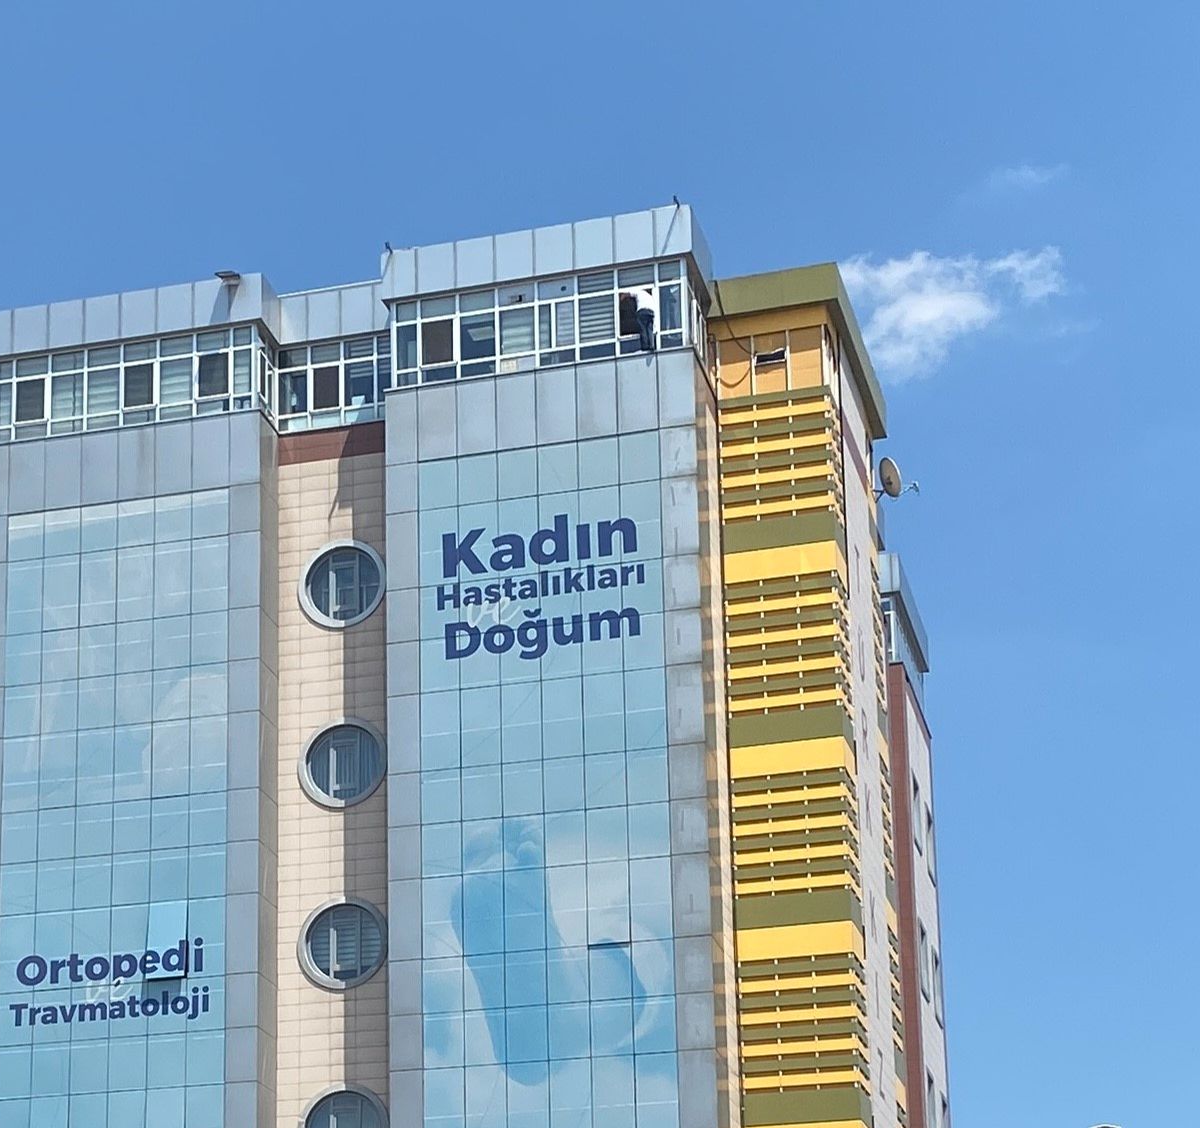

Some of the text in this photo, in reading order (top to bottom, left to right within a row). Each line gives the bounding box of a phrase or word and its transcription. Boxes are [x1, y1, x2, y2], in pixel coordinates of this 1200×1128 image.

[441, 513, 638, 579] Kadın
[436, 563, 645, 611] Hastalıkları
[444, 607, 641, 661] Doğum
[466, 596, 522, 628] ve
[16, 937, 204, 987] Ortopedi
[9, 985, 210, 1027] Travmatoloji
